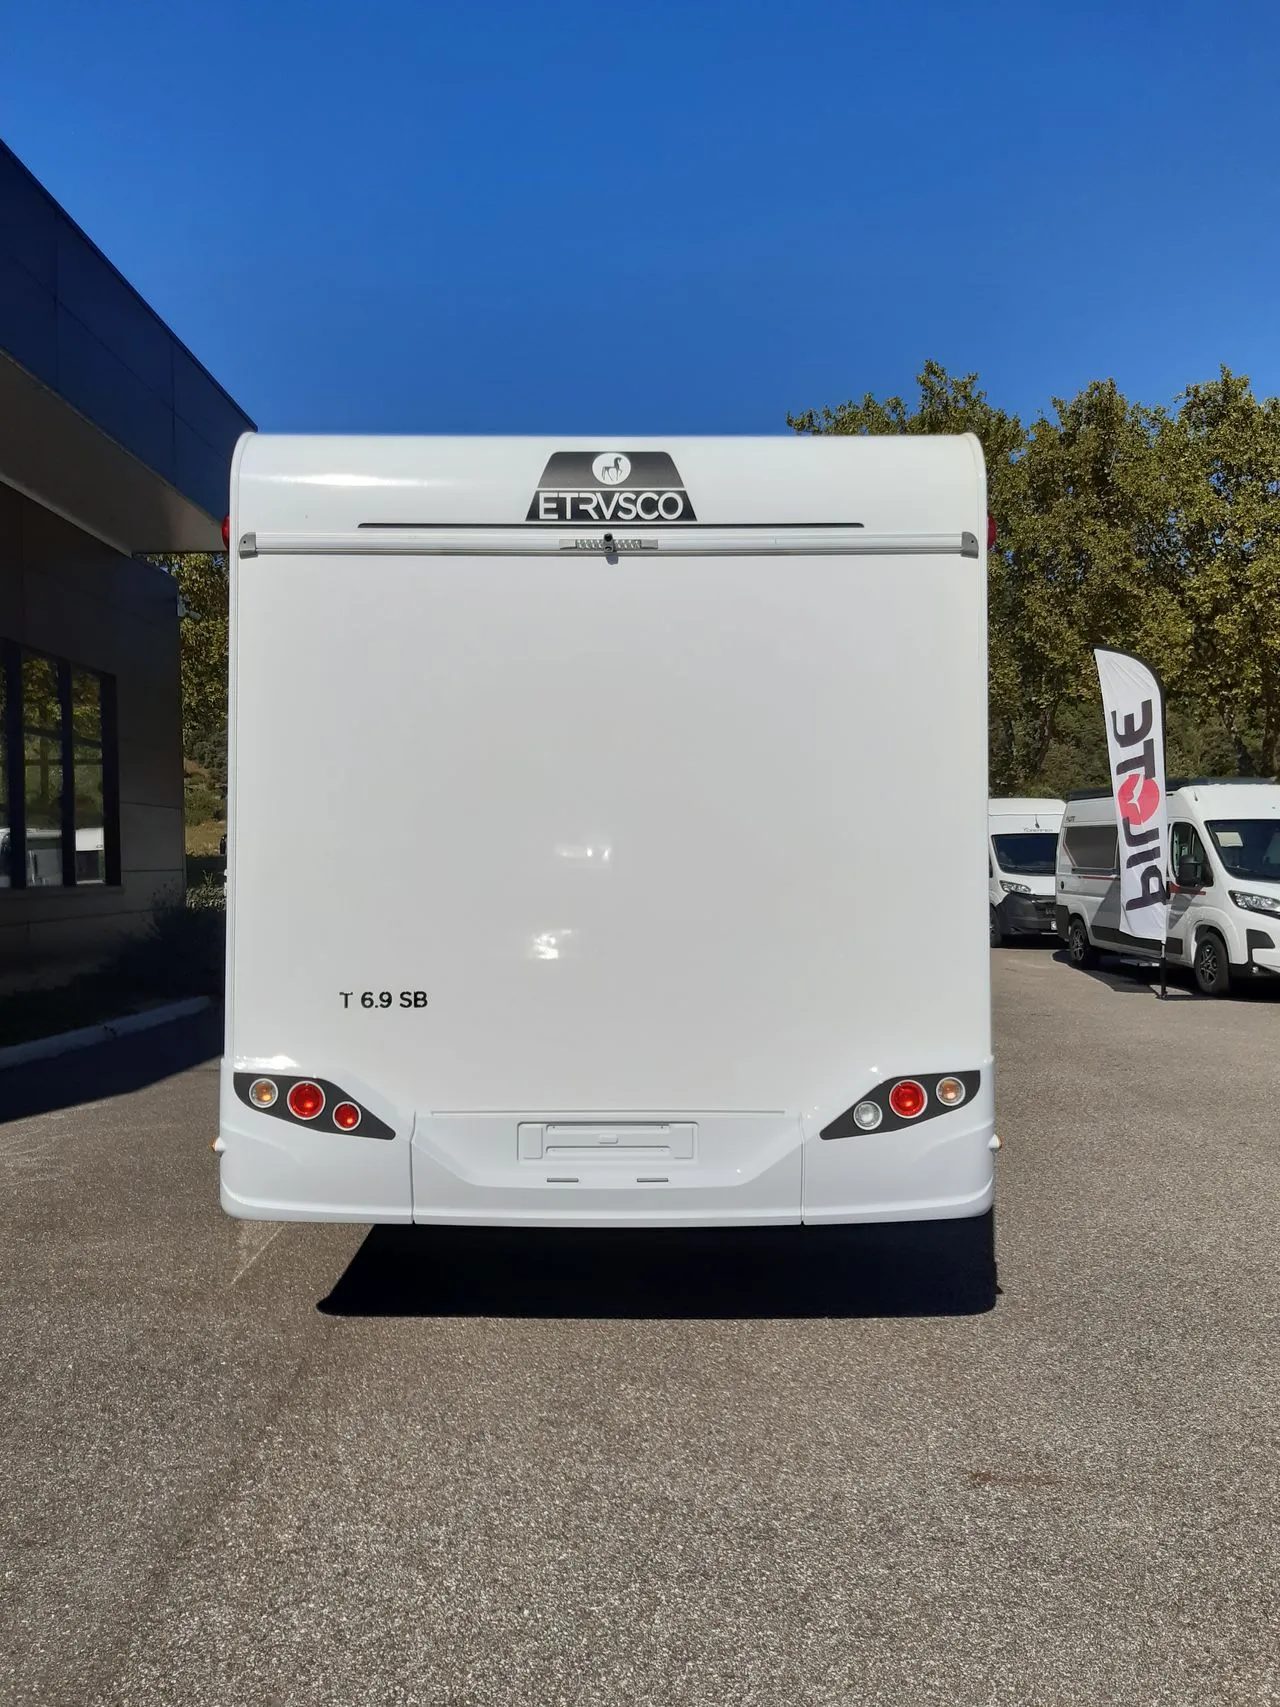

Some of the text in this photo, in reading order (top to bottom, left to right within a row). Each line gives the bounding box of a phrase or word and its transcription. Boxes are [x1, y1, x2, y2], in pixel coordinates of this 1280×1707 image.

[538, 491, 684, 521] ETRVSCO
[339, 991, 428, 1009] T 6.9 SB
